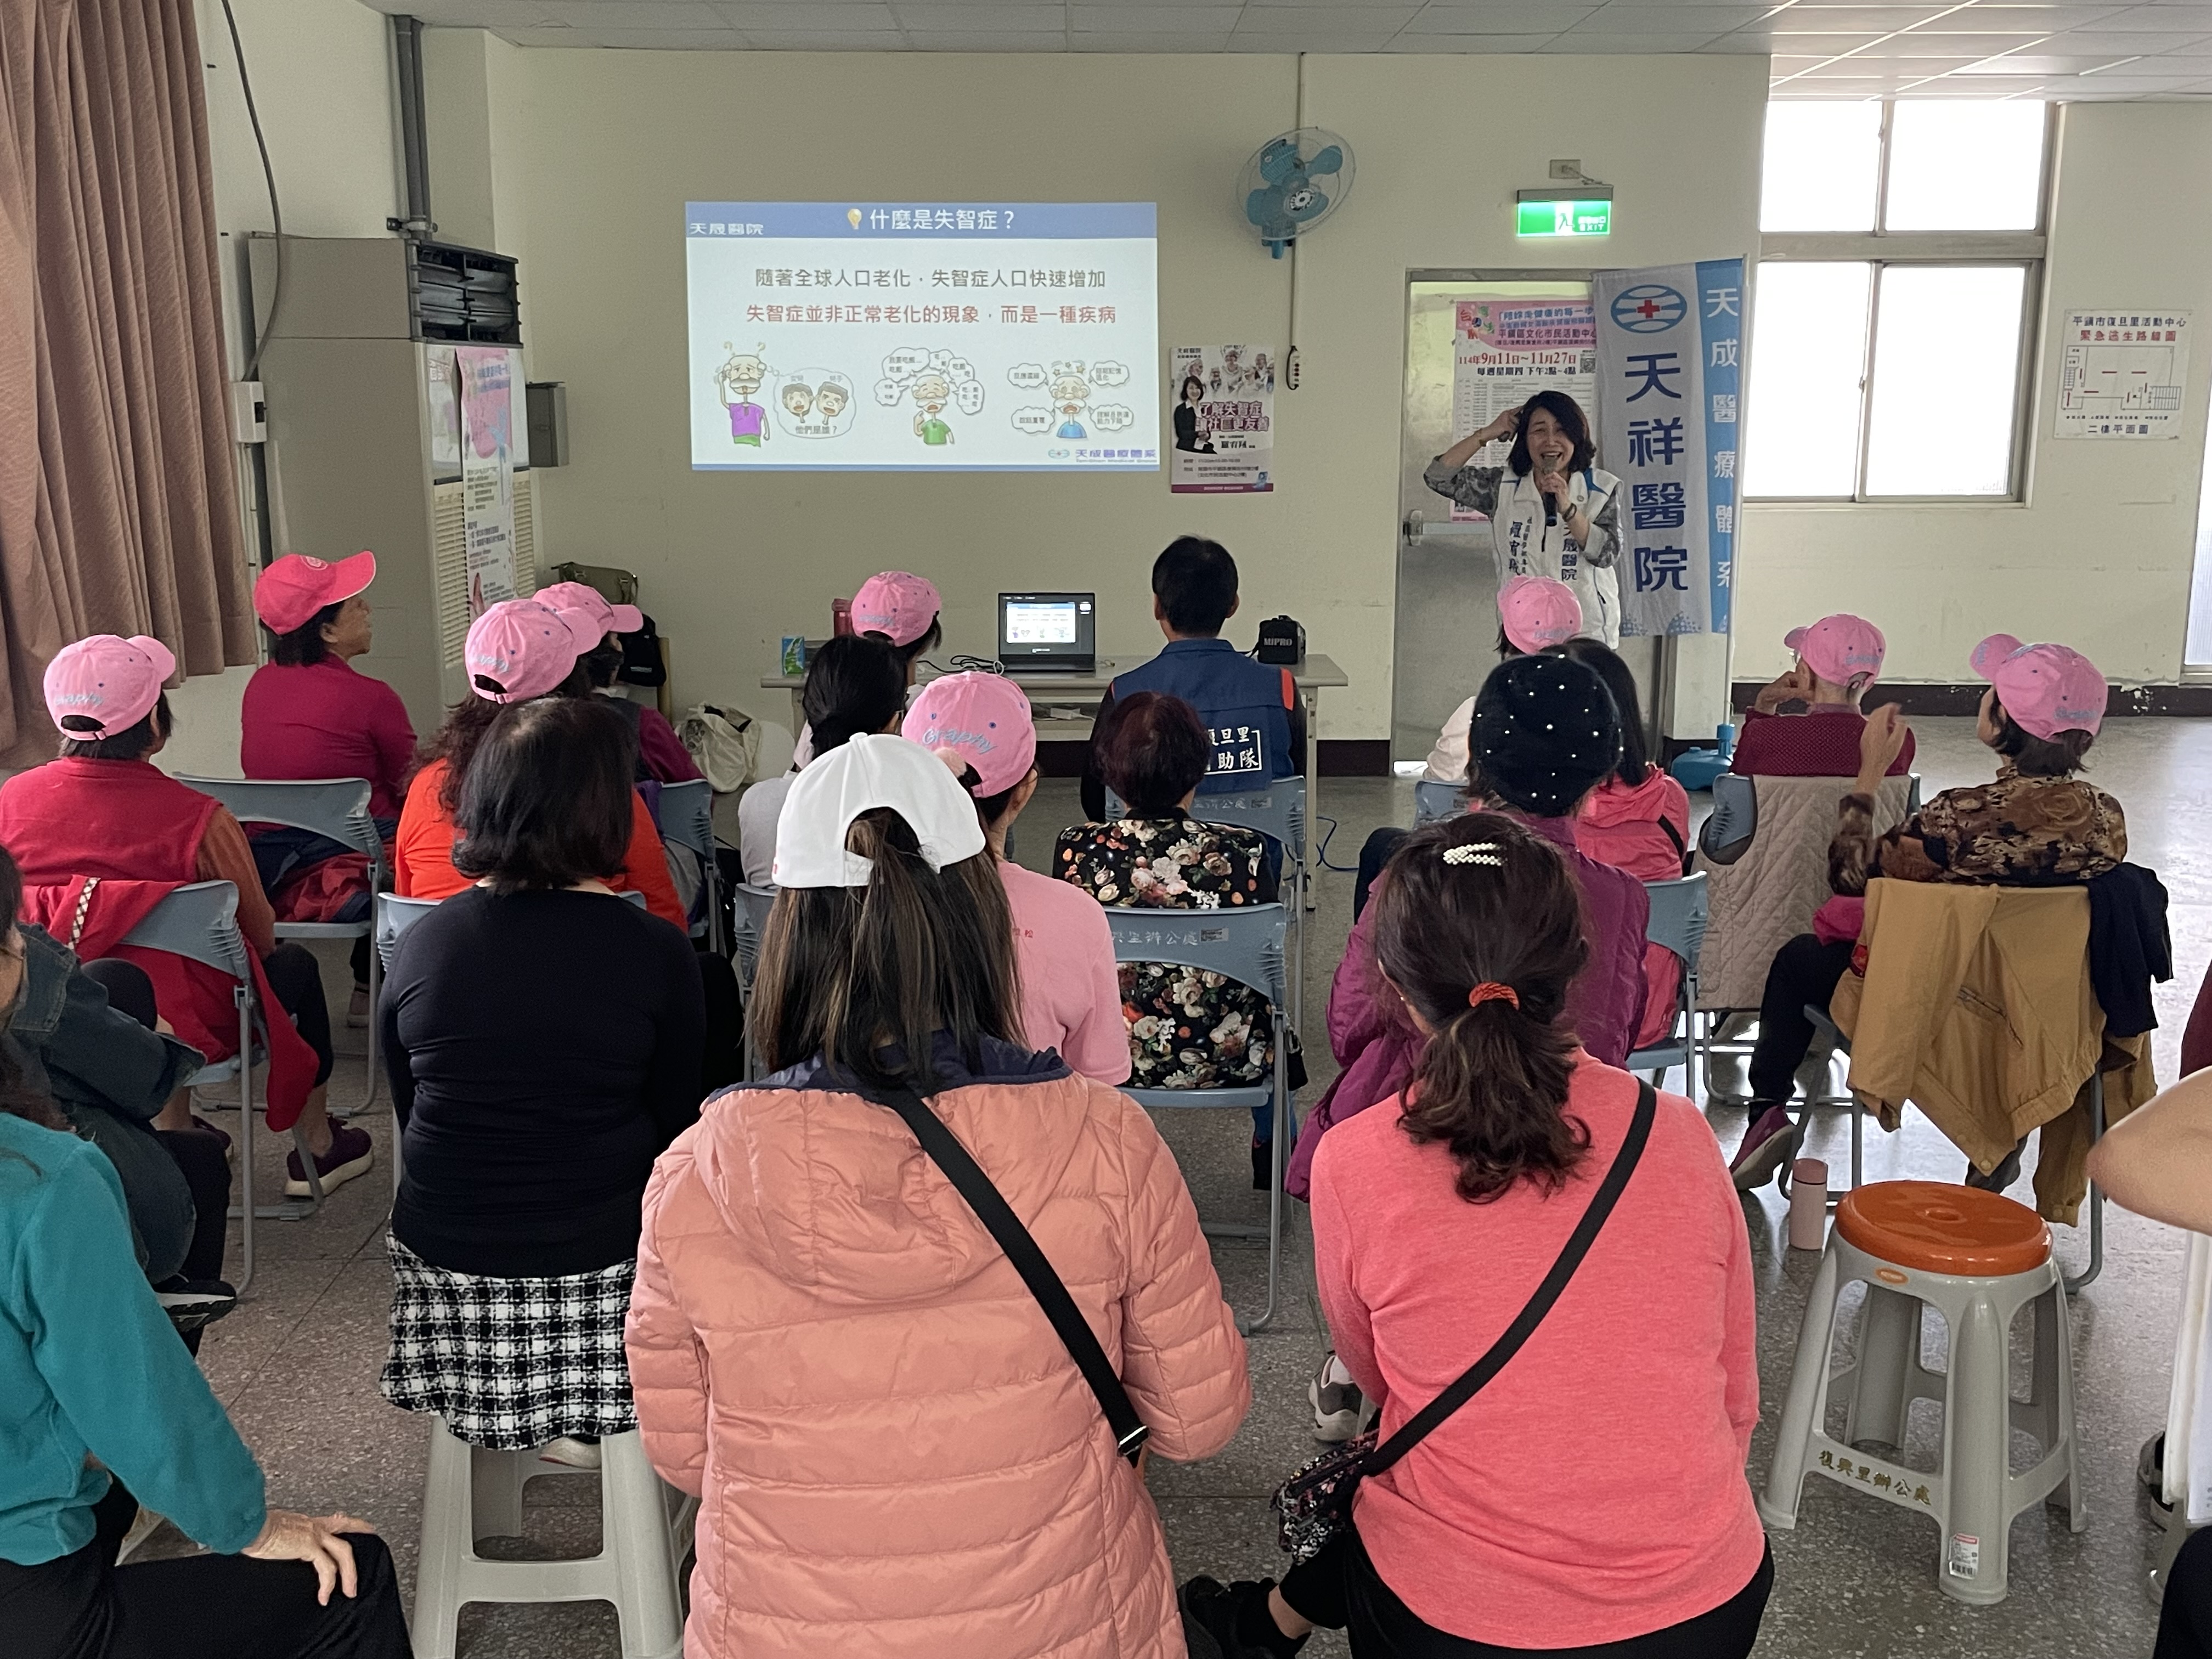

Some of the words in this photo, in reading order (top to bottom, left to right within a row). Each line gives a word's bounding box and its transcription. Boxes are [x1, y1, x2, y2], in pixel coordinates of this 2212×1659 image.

[690, 223, 764, 235] 天晟醫院
[870, 209, 1014, 230] 什麼是失智症？
[2072, 316, 2187, 328] 平鎮市復旦里活動中心
[1477, 367, 1523, 376] 每週星期四
[1200, 401, 1263, 417] 了解失智症
[1706, 287, 1739, 588] 天成醫療體系
[1624, 352, 1689, 592] 天祥醫院
[1207, 747, 1260, 771] 助隊
[1818, 1449, 1932, 1506] 復興里辦公處
